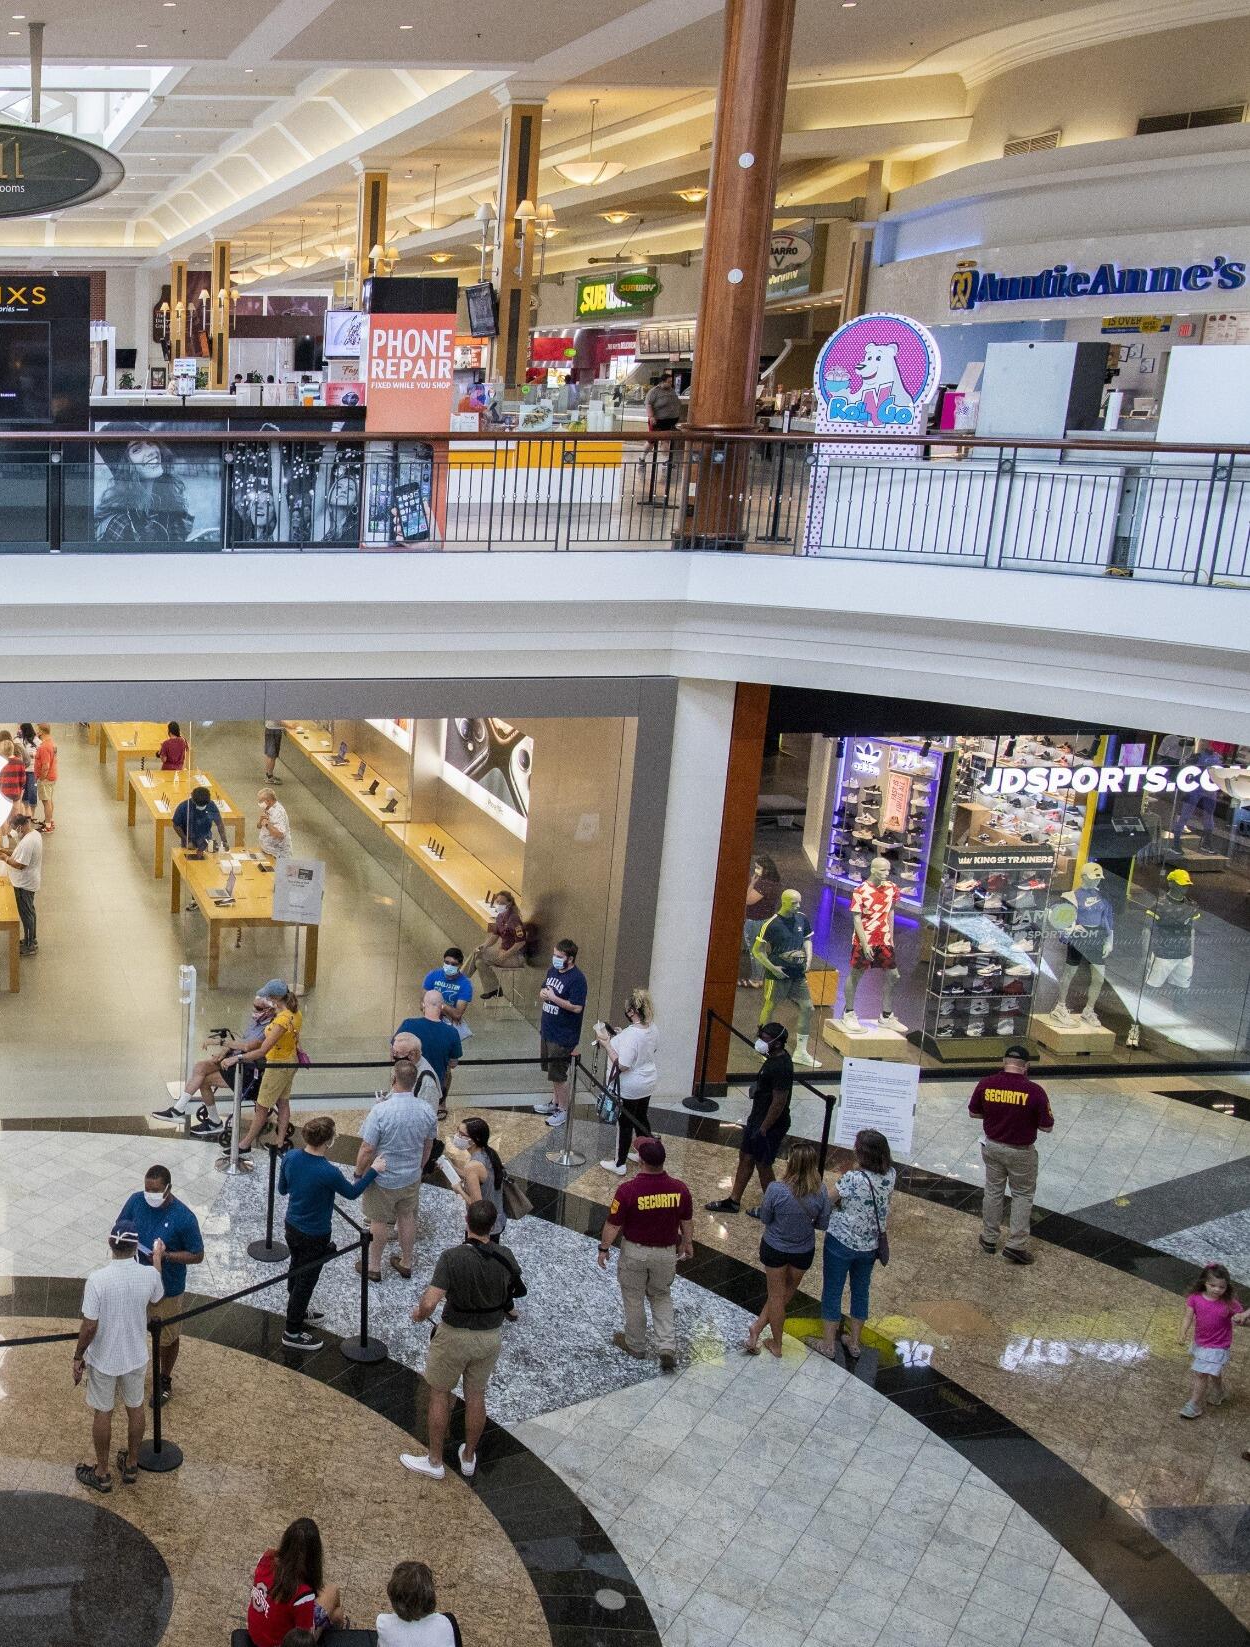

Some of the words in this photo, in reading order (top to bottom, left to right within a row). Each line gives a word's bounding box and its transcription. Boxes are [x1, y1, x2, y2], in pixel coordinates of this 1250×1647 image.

[1088, 255, 1247, 296] Anne's
[619, 283, 657, 292] SUBWAY
[372, 329, 453, 358] PHONE
[371, 358, 452, 379] REPAIR
[371, 381, 392, 389] FIXED
[392, 381, 415, 389] WHILE
[416, 381, 431, 389] YOU
[431, 381, 451, 389] SHOP
[979, 765, 1250, 793] JDSPORTS.CO
[973, 856, 996, 864] KING
[997, 856, 1007, 864] OF
[1008, 856, 1054, 864] TRAINERS
[984, 1088, 1029, 1106] SECURITY
[637, 1193, 682, 1211] SECURITY
